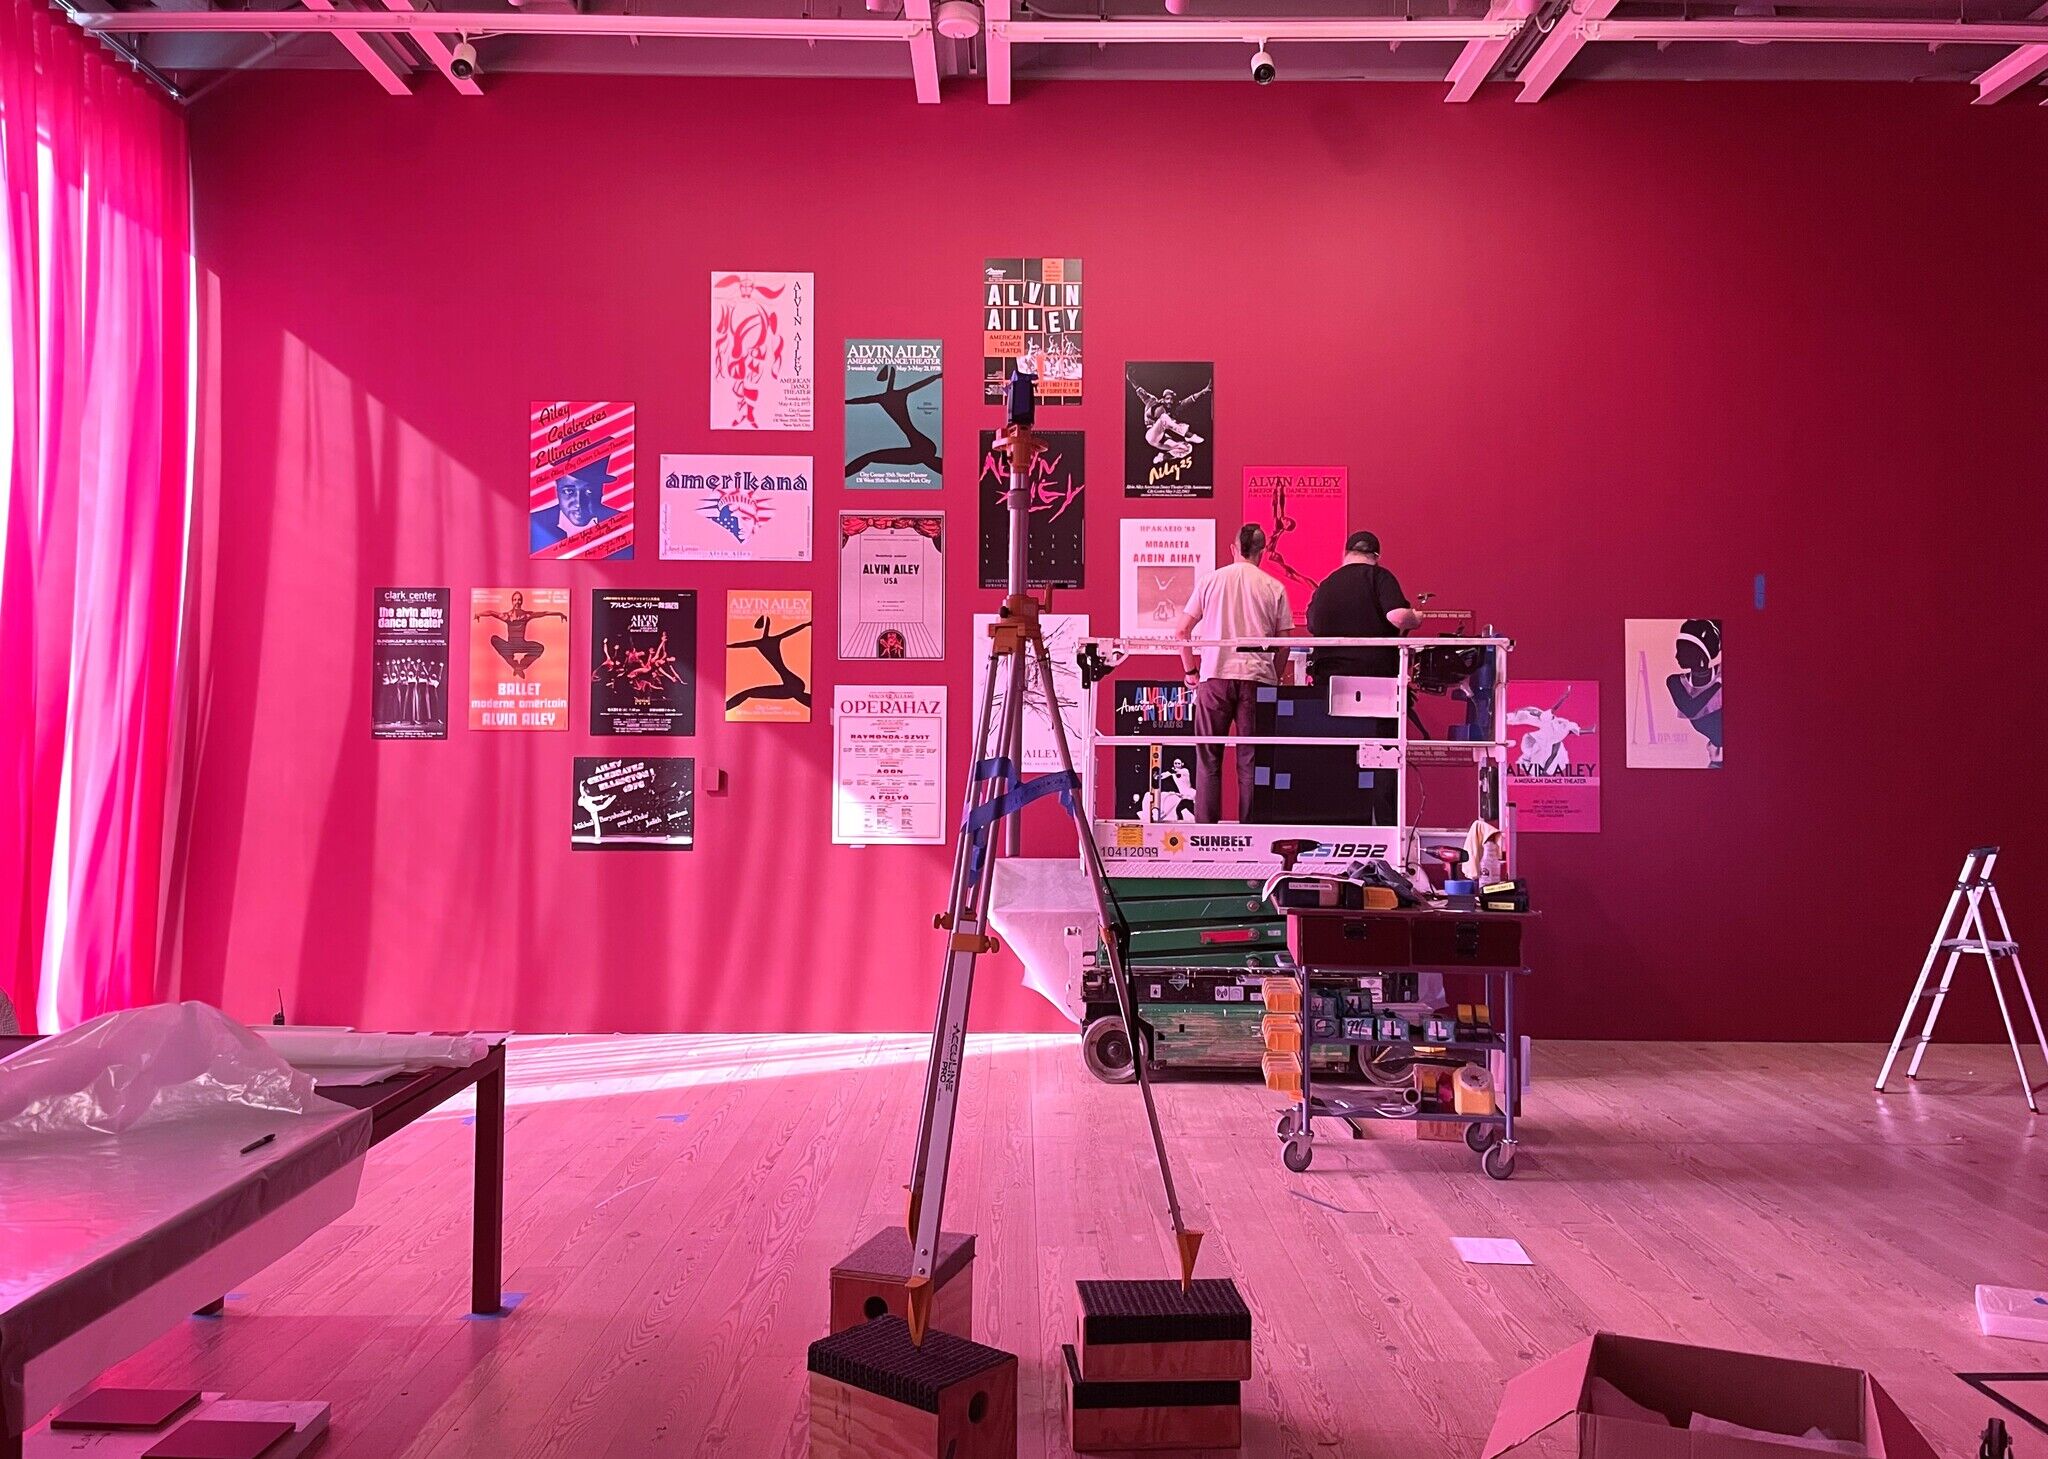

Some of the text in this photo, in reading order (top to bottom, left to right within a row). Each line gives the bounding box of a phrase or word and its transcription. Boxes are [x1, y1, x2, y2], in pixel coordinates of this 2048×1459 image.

[988, 282, 1079, 306] ALVIN
[793, 281, 802, 325] ALVIN
[987, 309, 1079, 333] AILEY
[793, 332, 802, 376] AILEY
[846, 344, 941, 359] ALVIN AILEY
[539, 403, 571, 425] Ailey
[548, 410, 607, 443] Celebrates
[536, 437, 591, 469] Ellington
[1180, 456, 1193, 469] 25
[665, 471, 808, 492] amerikana
[1249, 476, 1342, 487] ALVIN AILEY
[1133, 554, 1201, 563] ΑΛΒΙΝ ΑΙΗΛΥ
[863, 564, 919, 575] ALVIN AILEY
[384, 591, 437, 600] clark center
[729, 598, 809, 609] ALVIN AILEY
[379, 607, 443, 619] the alvin ailey
[378, 618, 444, 628] dance theater
[497, 683, 541, 696] BALLET
[1135, 687, 1167, 704] ALVIN
[471, 699, 515, 708] moderne
[1116, 697, 1155, 715] American
[482, 713, 556, 726] ALVIN AILEY
[1158, 704, 1193, 721] TIVOLI
[1024, 750, 1059, 758] AILEY
[587, 762, 645, 785] CELEBRATES
[594, 760, 622, 774] AILEY
[1507, 763, 1596, 777] ALVIN AILEY
[599, 809, 633, 823] Baryshnikov
[1190, 835, 1253, 847] SUNBELT
[1101, 846, 1159, 857] 10412099
[1345, 996, 1367, 1014] XL
[1435, 1020, 1450, 1040] L
[945, 1023, 961, 1092] ACCULINE
[940, 1061, 948, 1083] PRO
